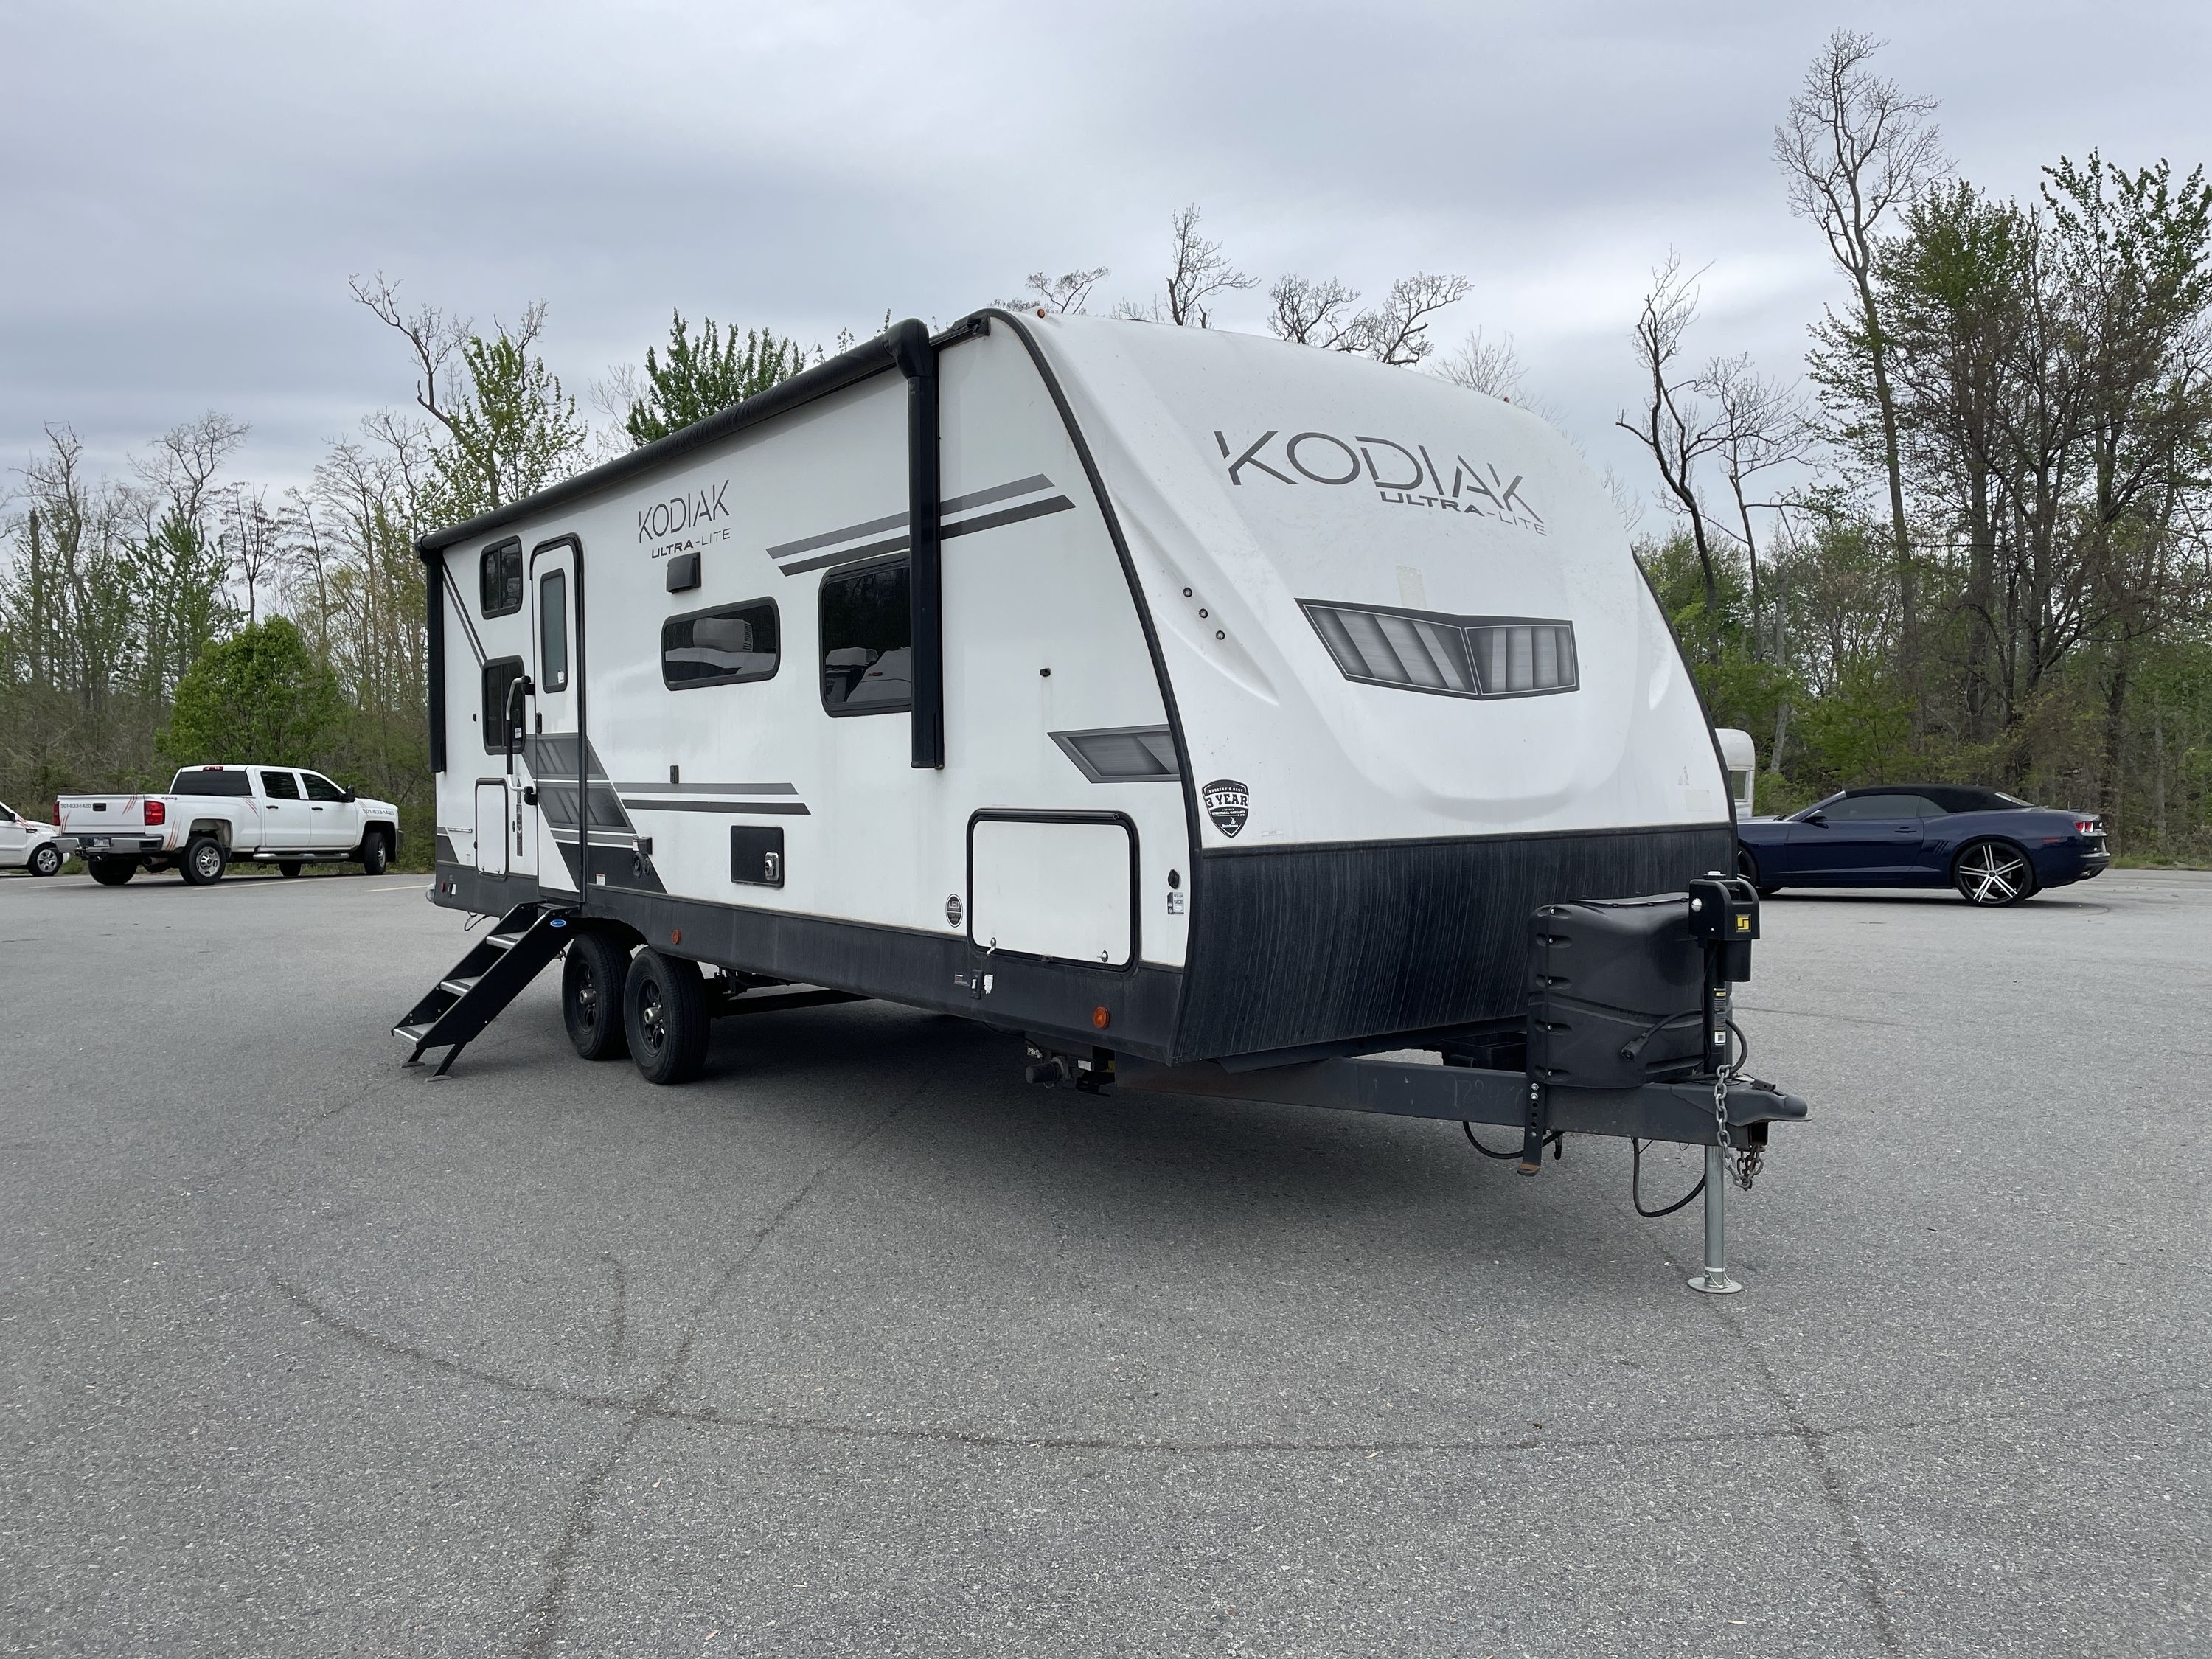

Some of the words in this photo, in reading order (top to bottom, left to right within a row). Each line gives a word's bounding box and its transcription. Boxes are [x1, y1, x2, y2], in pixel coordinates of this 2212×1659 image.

[1214, 431, 1543, 523] KODIAK
[639, 479, 730, 543] KODIAK
[1380, 491, 1547, 537] ULTRA-LITE
[651, 527, 731, 559] ULTRA-LITE
[1206, 797, 1214, 809] 3
[1215, 793, 1248, 807] YEAR
[948, 900, 960, 909] LED
